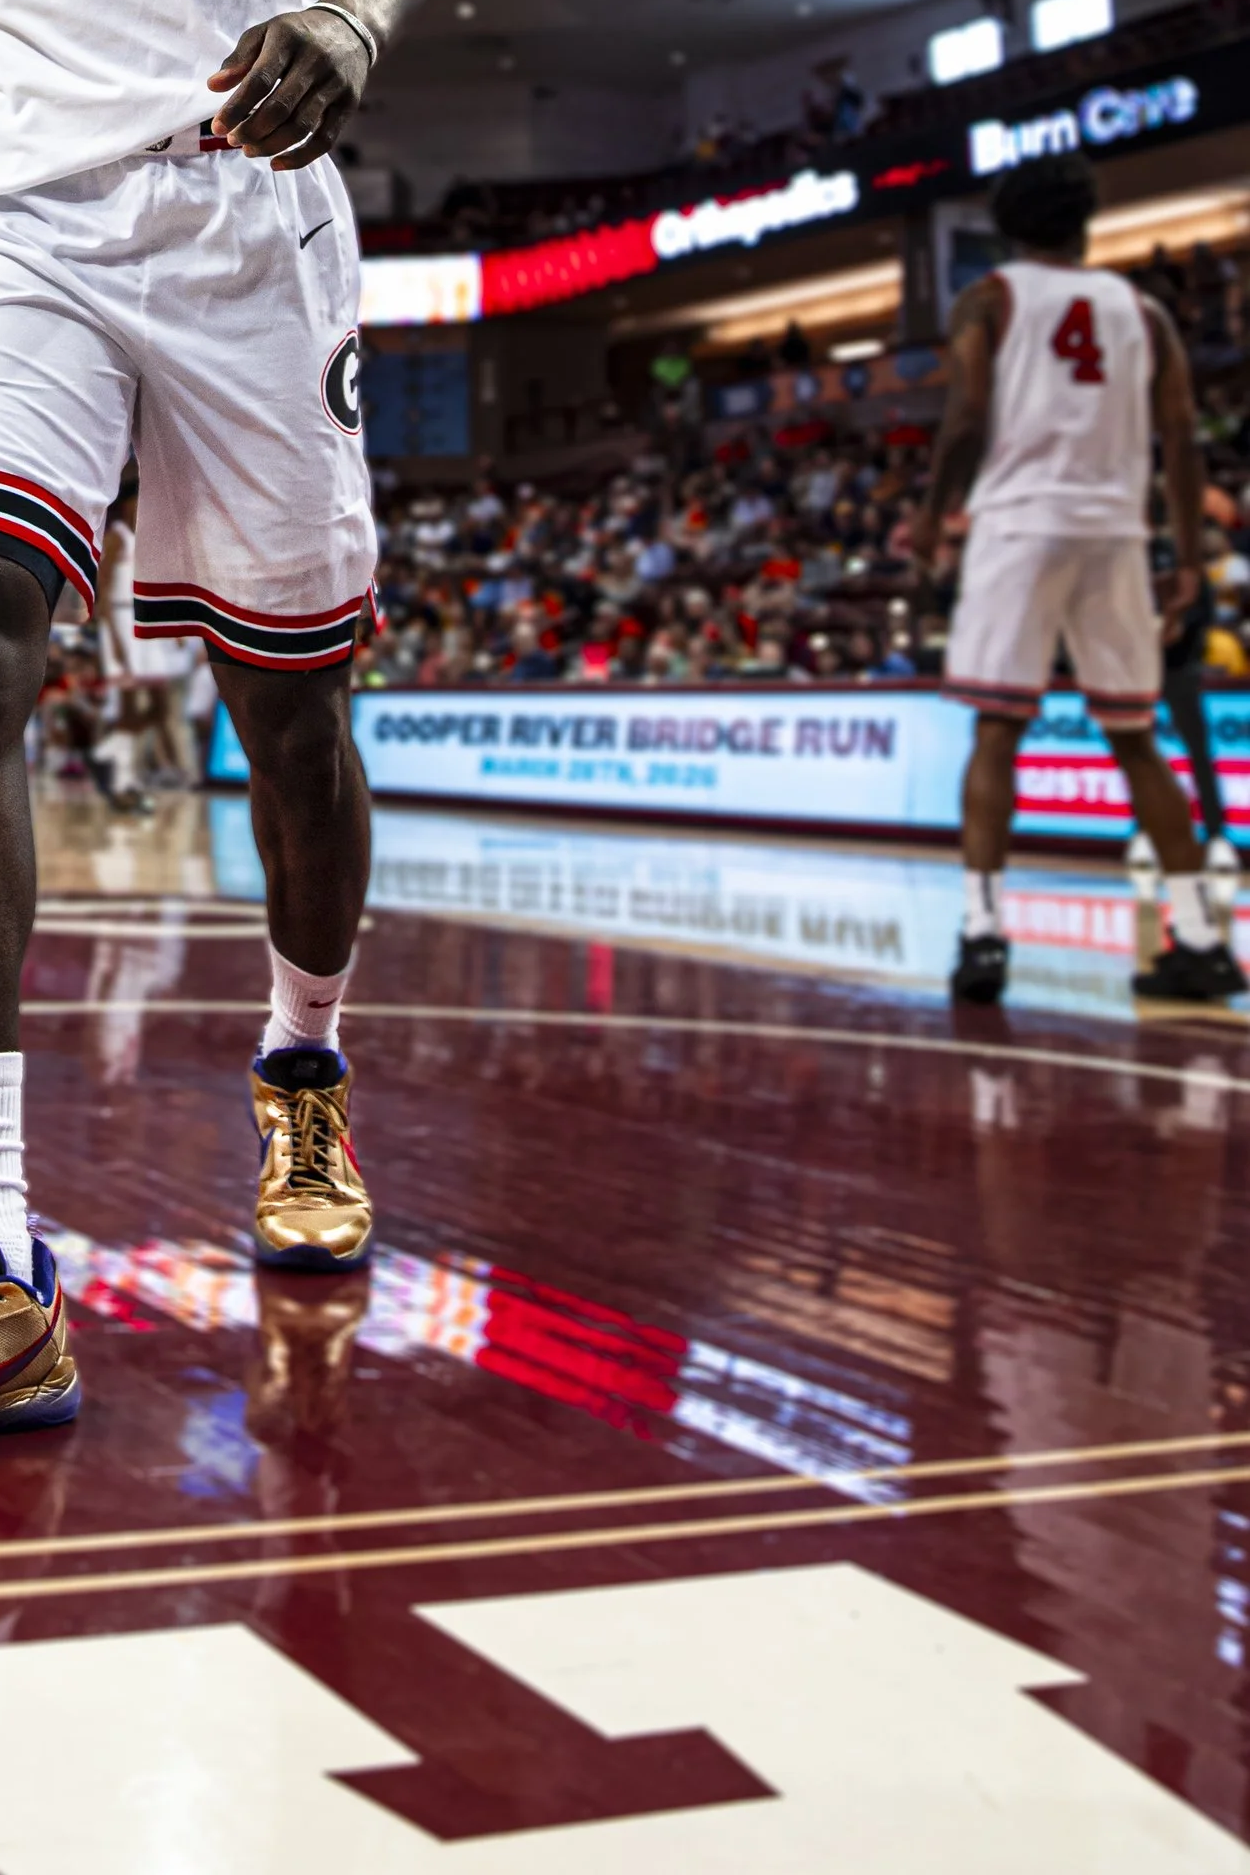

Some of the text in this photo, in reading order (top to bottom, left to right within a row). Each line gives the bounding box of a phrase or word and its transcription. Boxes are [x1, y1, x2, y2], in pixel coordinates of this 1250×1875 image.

[1052, 295, 1105, 384] 4
[507, 714, 618, 751] RIVER
[625, 716, 782, 757] BRIDGE
[792, 719, 897, 759] RUN
